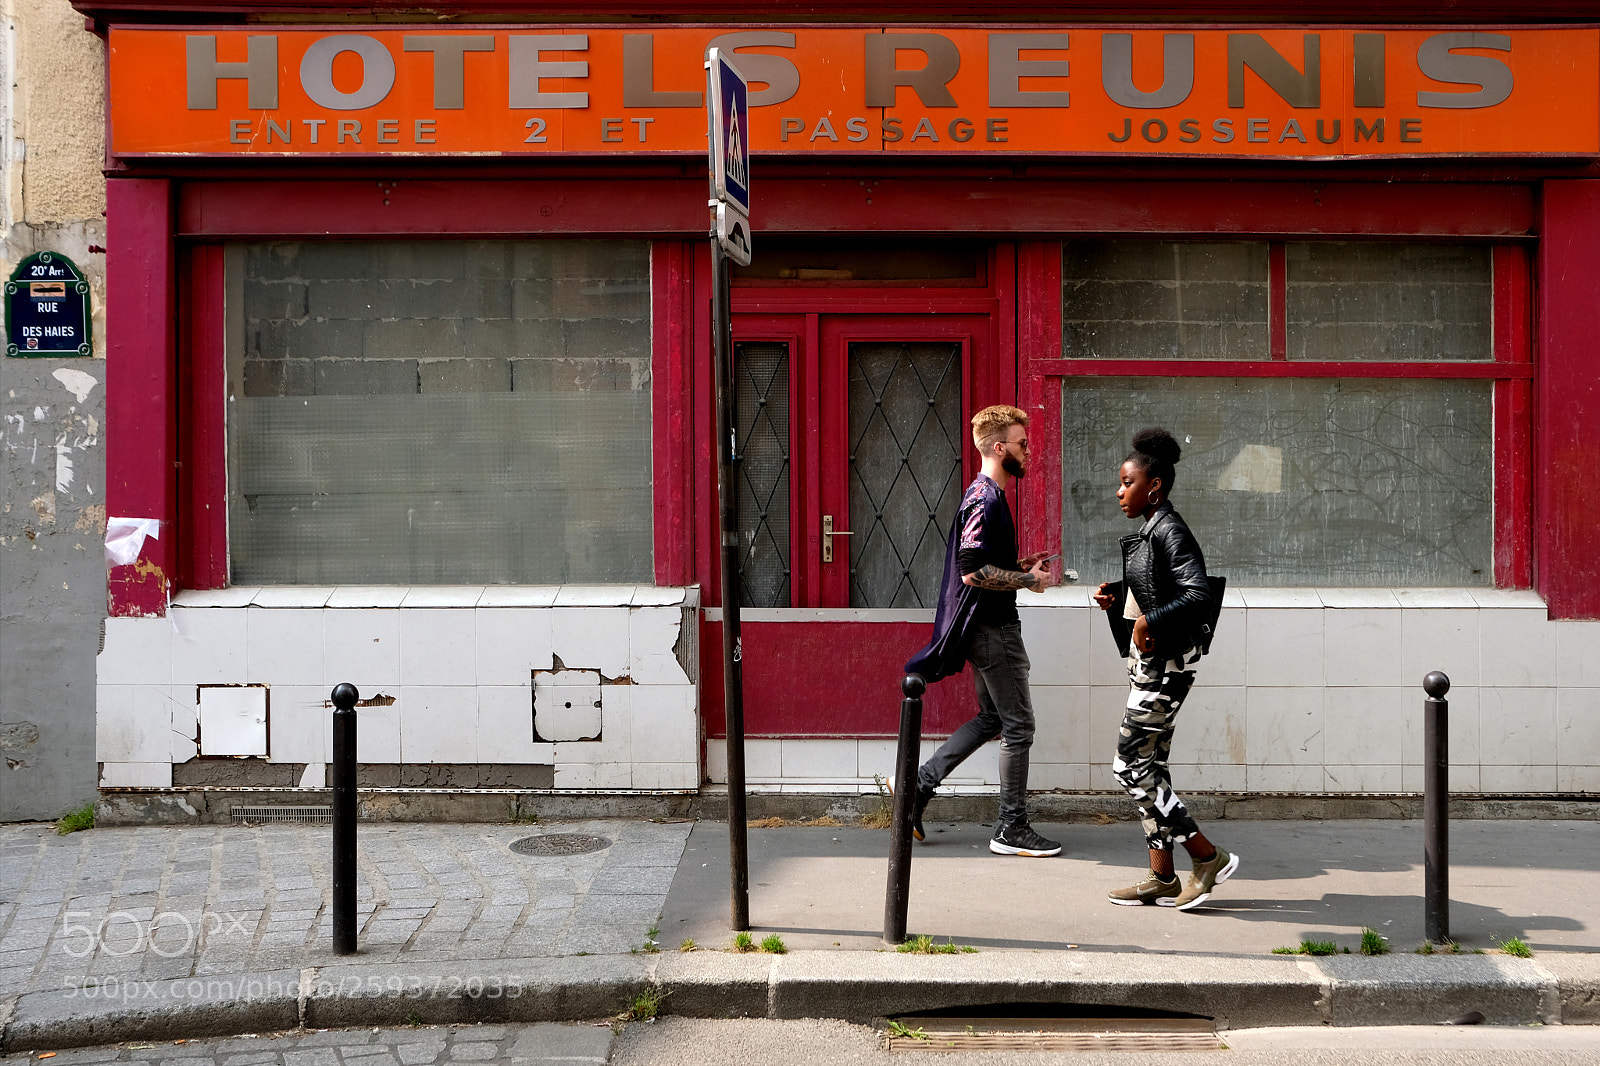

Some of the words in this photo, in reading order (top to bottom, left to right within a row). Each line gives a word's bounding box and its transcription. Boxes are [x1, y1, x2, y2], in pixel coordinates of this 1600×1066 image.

[186, 31, 801, 110] HOTELS
[865, 32, 1514, 109] REUNIS
[229, 119, 437, 144] ENTREE
[524, 117, 548, 143] 2
[601, 117, 655, 142] ET
[780, 117, 1008, 142] PASSAGE
[1107, 117, 1422, 144] JOSSEAUME
[37, 302, 59, 313] RUE
[22, 326, 42, 337] DES
[44, 326, 75, 337] HAIES
